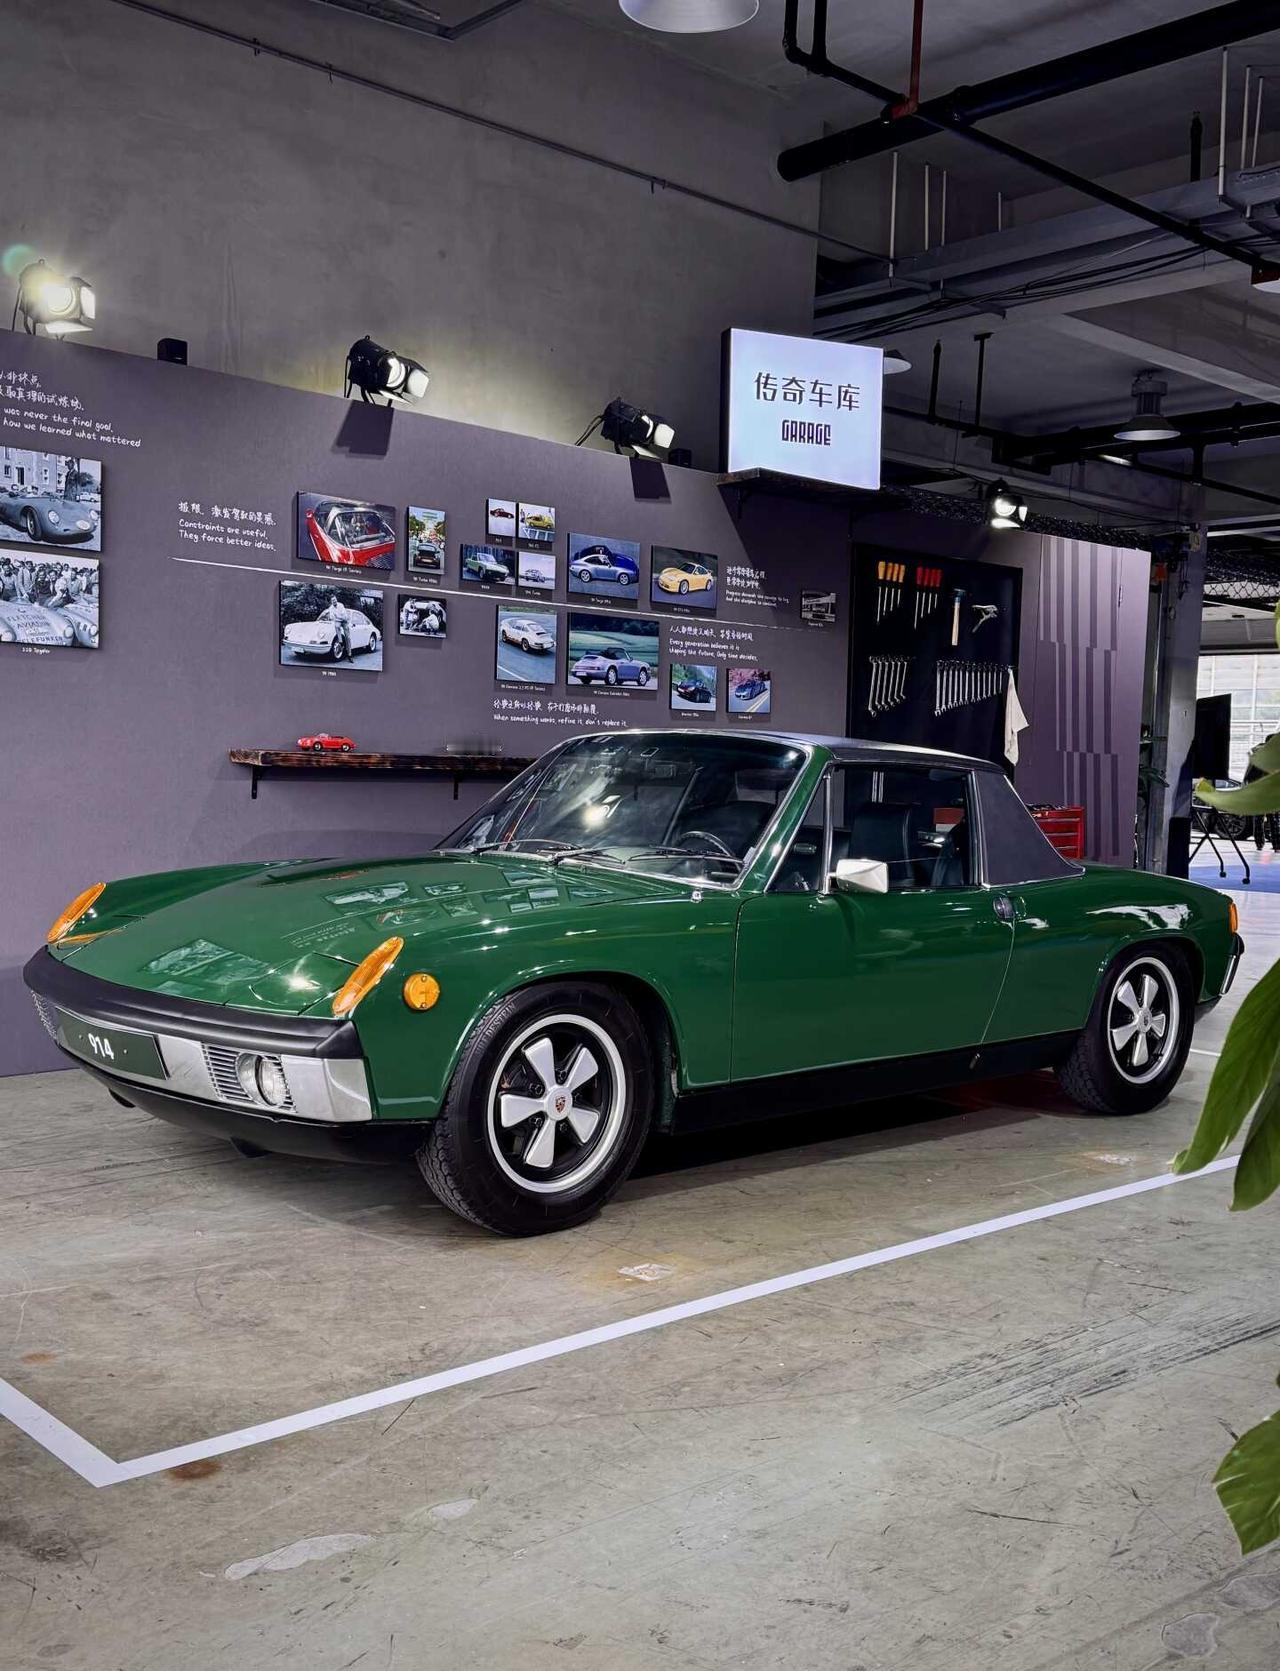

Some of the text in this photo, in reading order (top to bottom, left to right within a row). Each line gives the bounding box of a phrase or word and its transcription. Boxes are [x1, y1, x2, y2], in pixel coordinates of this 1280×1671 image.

[755, 371, 860, 411] 传奇车库
[3, 417, 20, 428] how
[39, 425, 72, 436] learned
[75, 430, 97, 440] what
[100, 435, 141, 448] mattered
[4, 407, 113, 433] was never the final goal.
[781, 419, 831, 446] GARAGE
[179, 519, 225, 533] Constraints
[242, 530, 268, 540] useful.
[179, 530, 277, 552] They force better ideas.
[510, 714, 538, 725] something
[88, 1033, 114, 1060] 914
